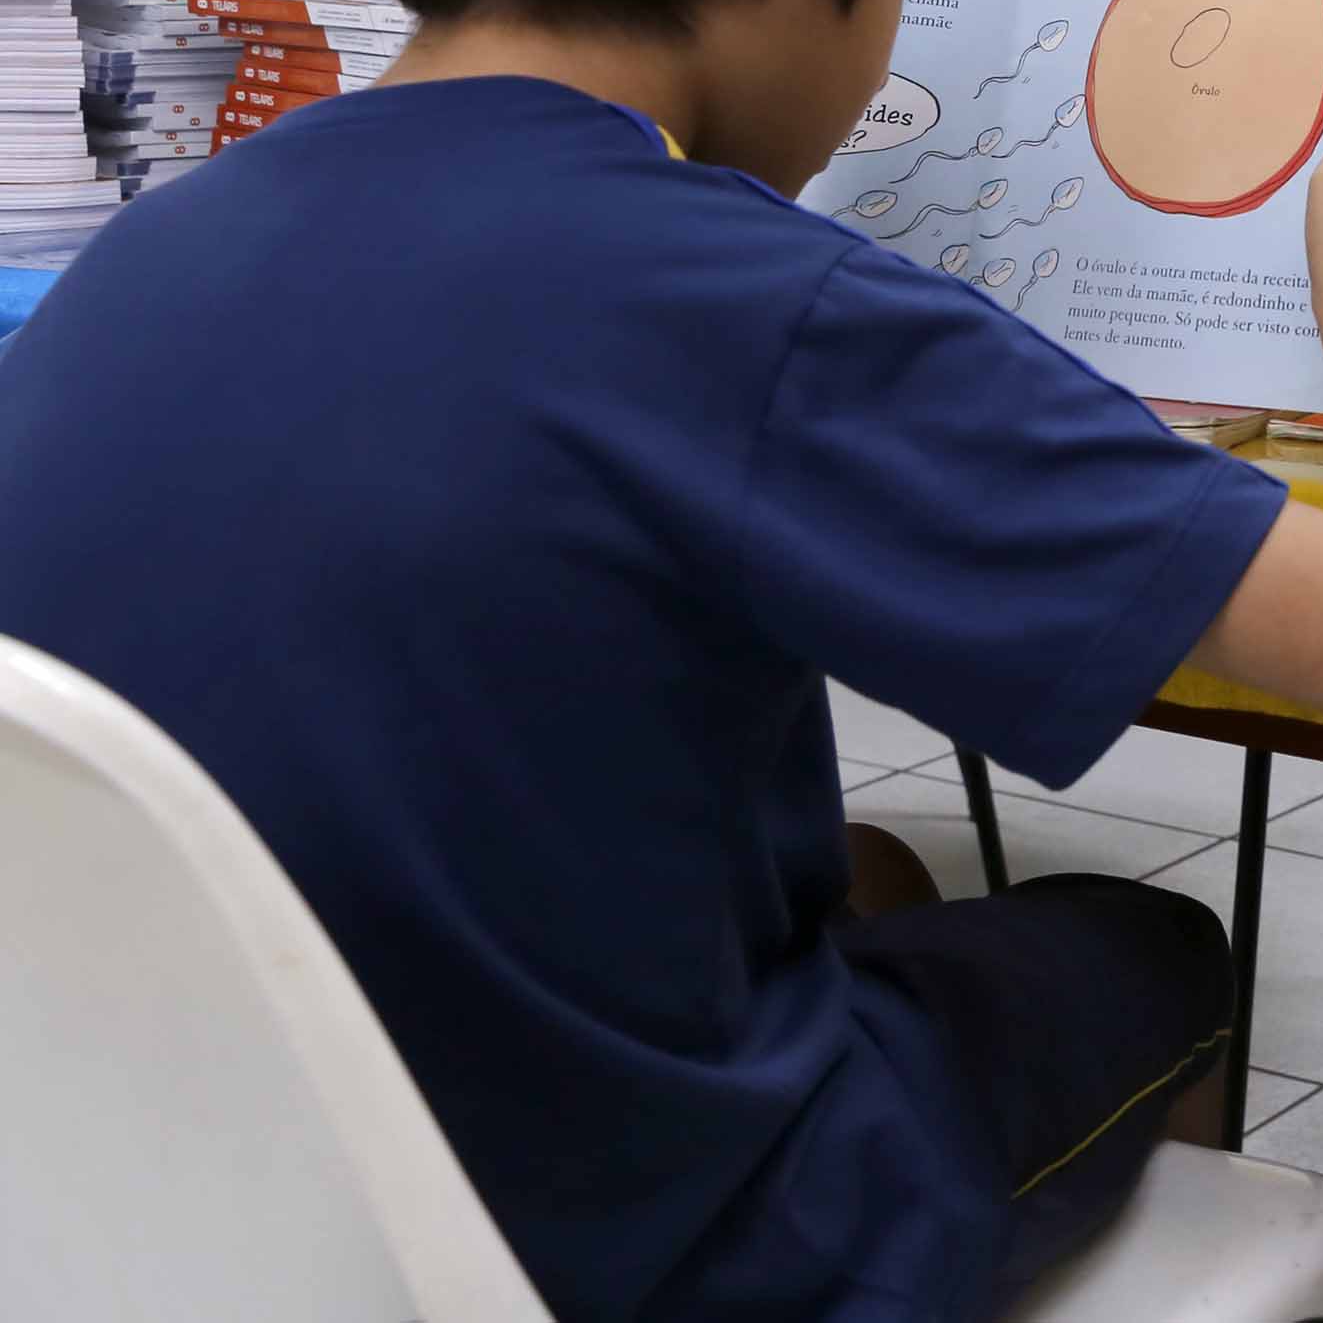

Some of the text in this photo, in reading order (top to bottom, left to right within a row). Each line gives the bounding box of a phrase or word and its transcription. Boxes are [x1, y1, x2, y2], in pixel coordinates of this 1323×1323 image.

[1076, 256, 1310, 289] O óvulo é a outra metade da receita
[1072, 279, 1307, 313] Ele vem da mamãe, é redondinho e
[1068, 306, 1106, 320] muito
[1109, 309, 1170, 327] pequeno.
[1174, 311, 1192, 326] Só
[1195, 314, 1228, 333] pode
[1232, 319, 1253, 332] ser
[1256, 320, 1290, 335] visto
[1064, 325, 1186, 350] lentes de aumento.
